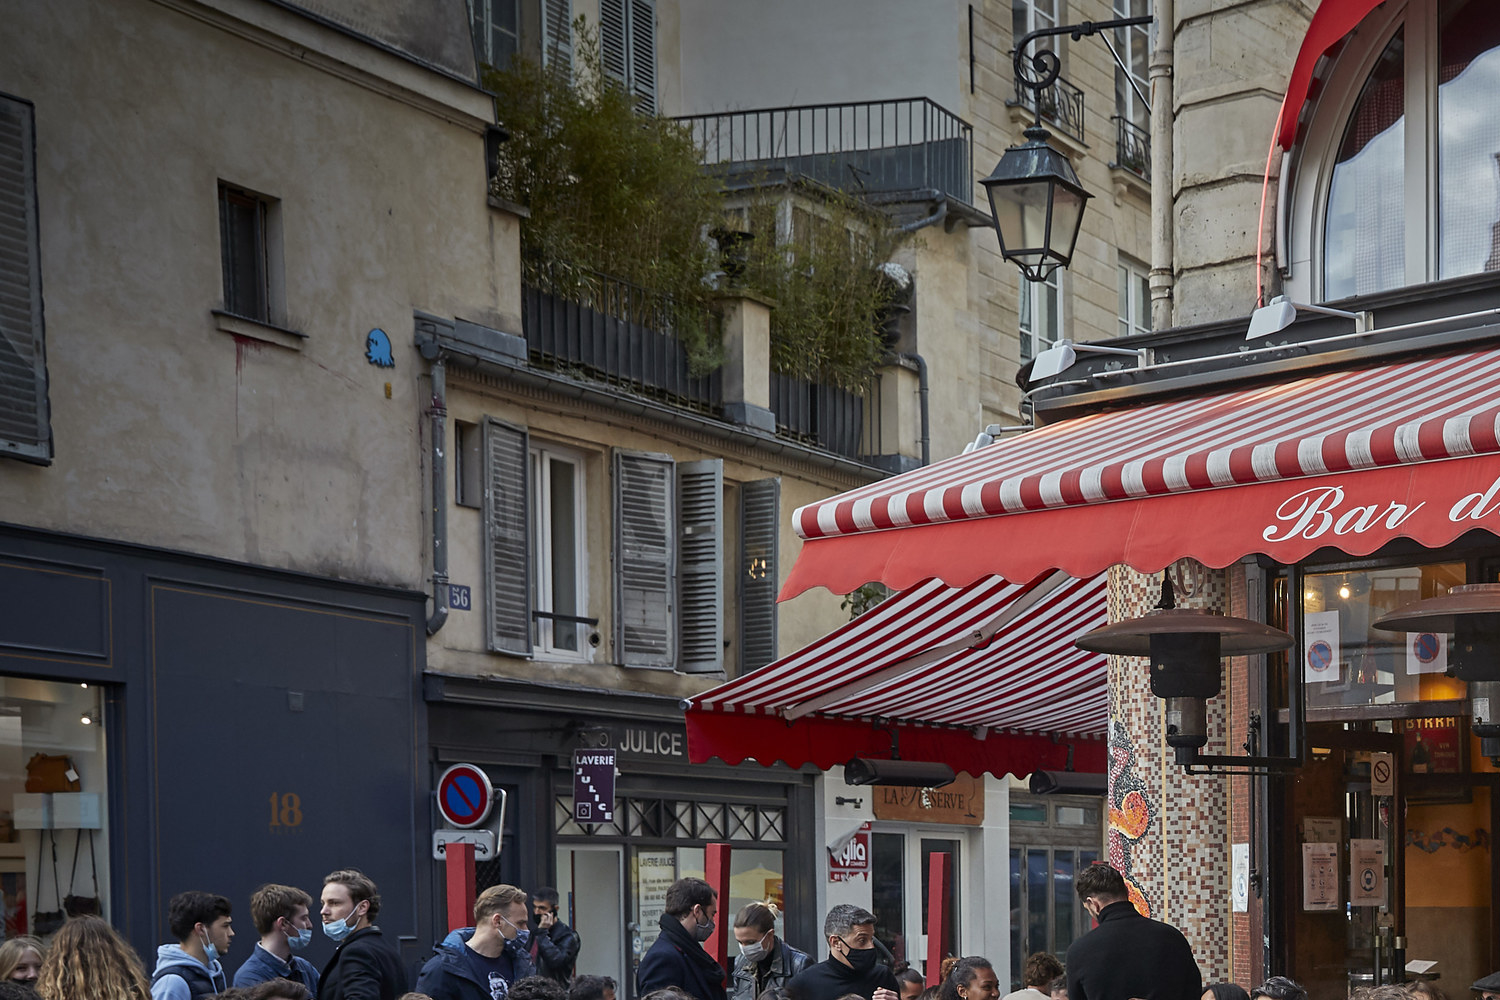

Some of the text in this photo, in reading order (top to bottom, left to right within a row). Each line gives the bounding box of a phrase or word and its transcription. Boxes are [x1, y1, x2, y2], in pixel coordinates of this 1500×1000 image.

[1262, 485, 1426, 543] Bar
[452, 587, 469, 607] 56
[1406, 716, 1455, 729] BYRRH
[620, 729, 682, 756] JULICE
[576, 755, 615, 765] LAVERIE
[269, 791, 303, 827] 18
[884, 785, 964, 809] LA RSERVE
